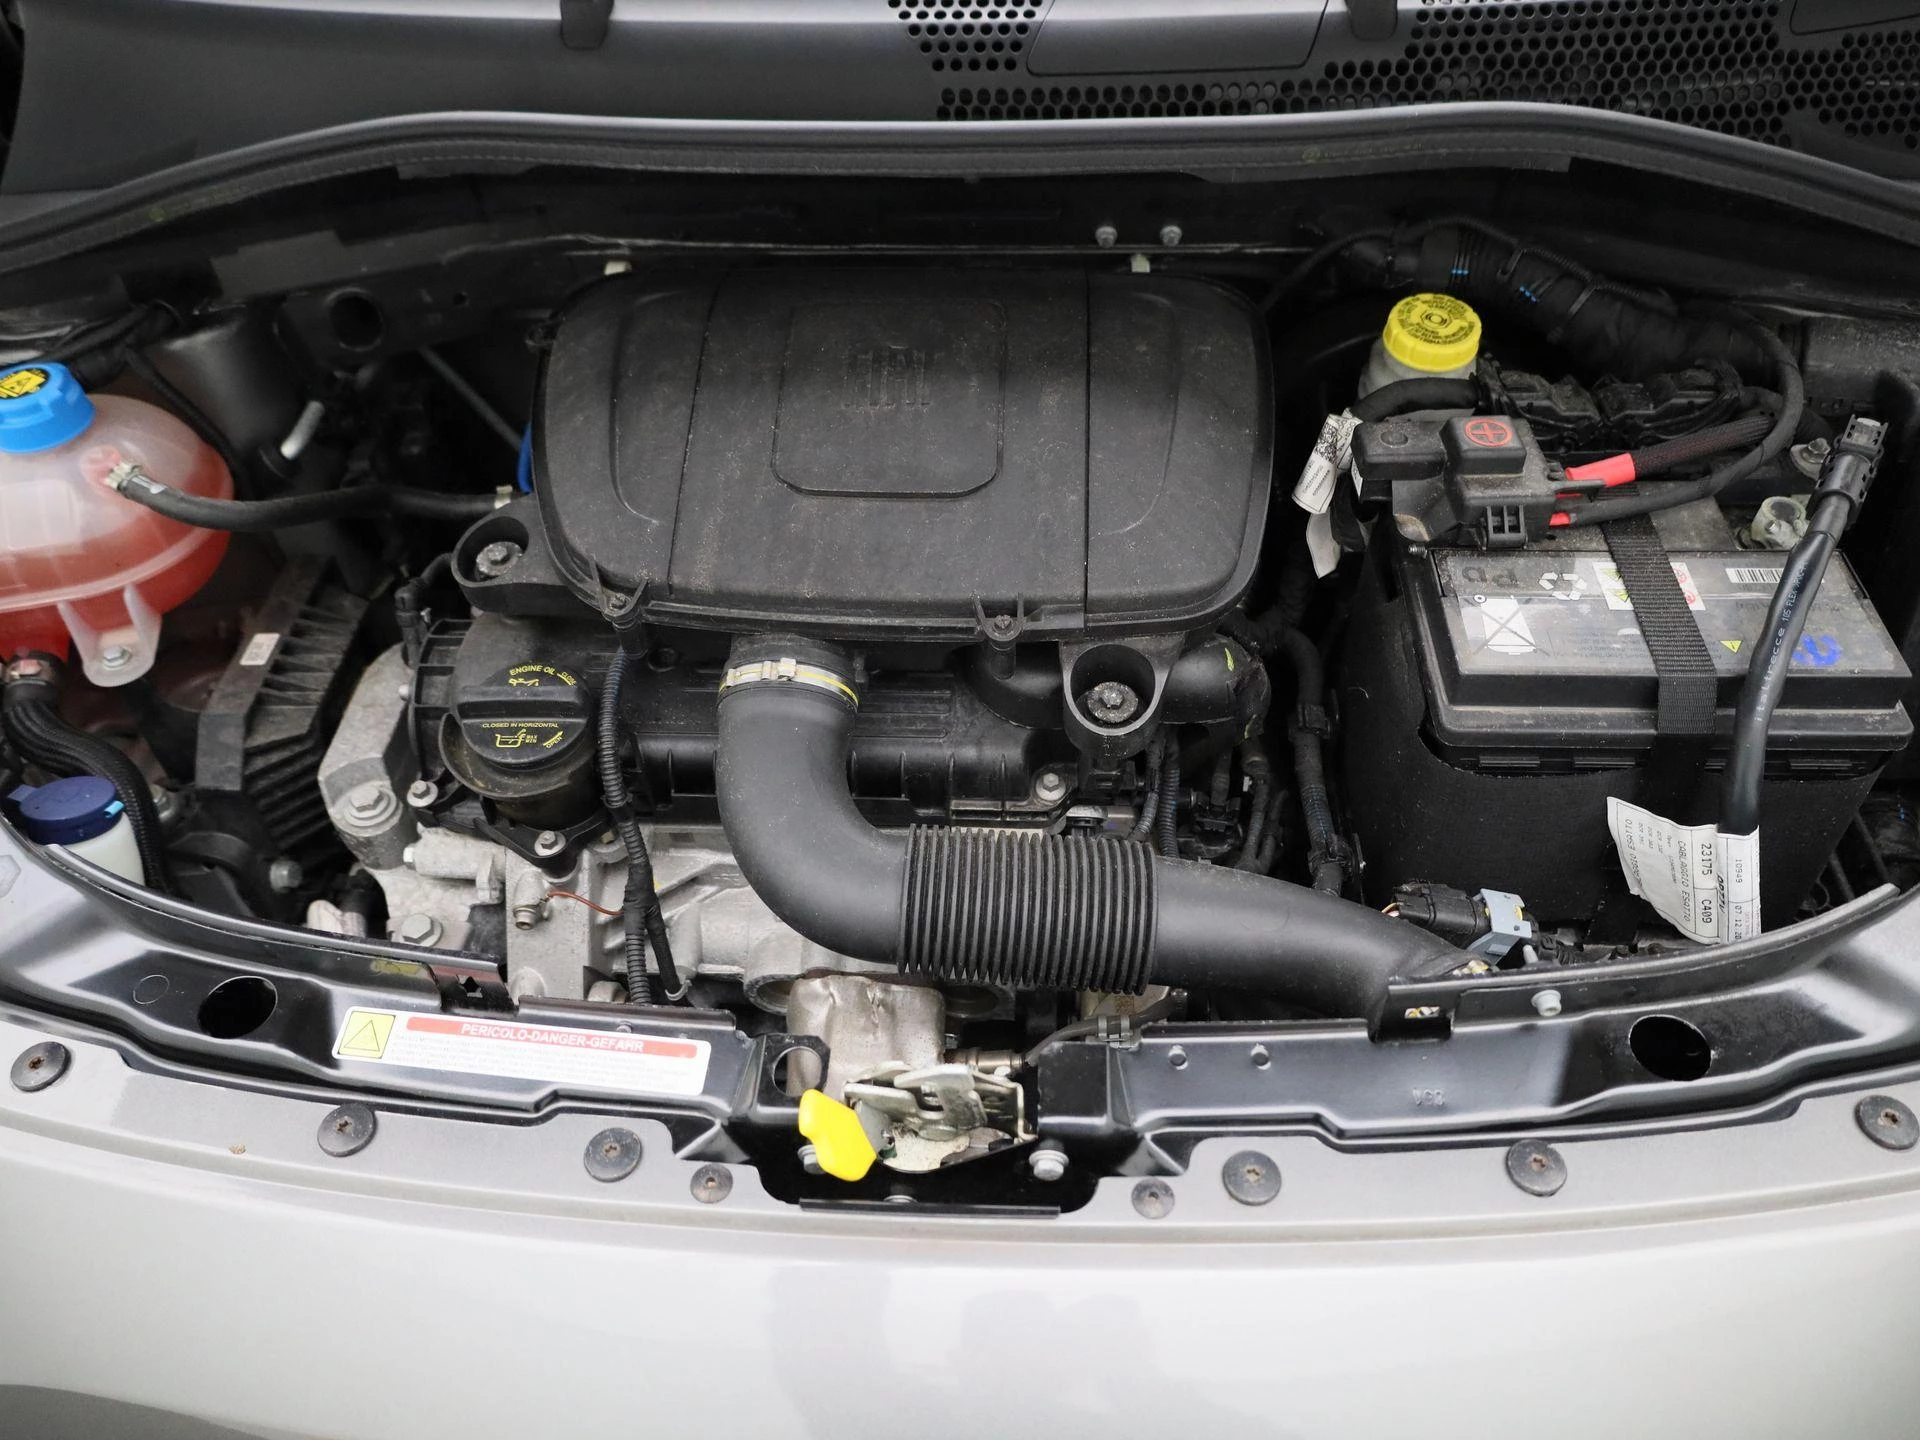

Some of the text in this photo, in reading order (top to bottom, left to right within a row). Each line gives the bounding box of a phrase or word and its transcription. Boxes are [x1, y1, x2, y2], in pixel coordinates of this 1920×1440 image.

[509, 665, 556, 676] ENGINE OIL
[1754, 628, 1786, 722] italtrecce
[545, 736, 563, 749] OPEN
[1701, 843, 1713, 876] 23175
[1677, 840, 1691, 922] CABLAGGIO ESATTO
[460, 1022, 645, 1054] PERICOLO-DANGER-GEFAHR
